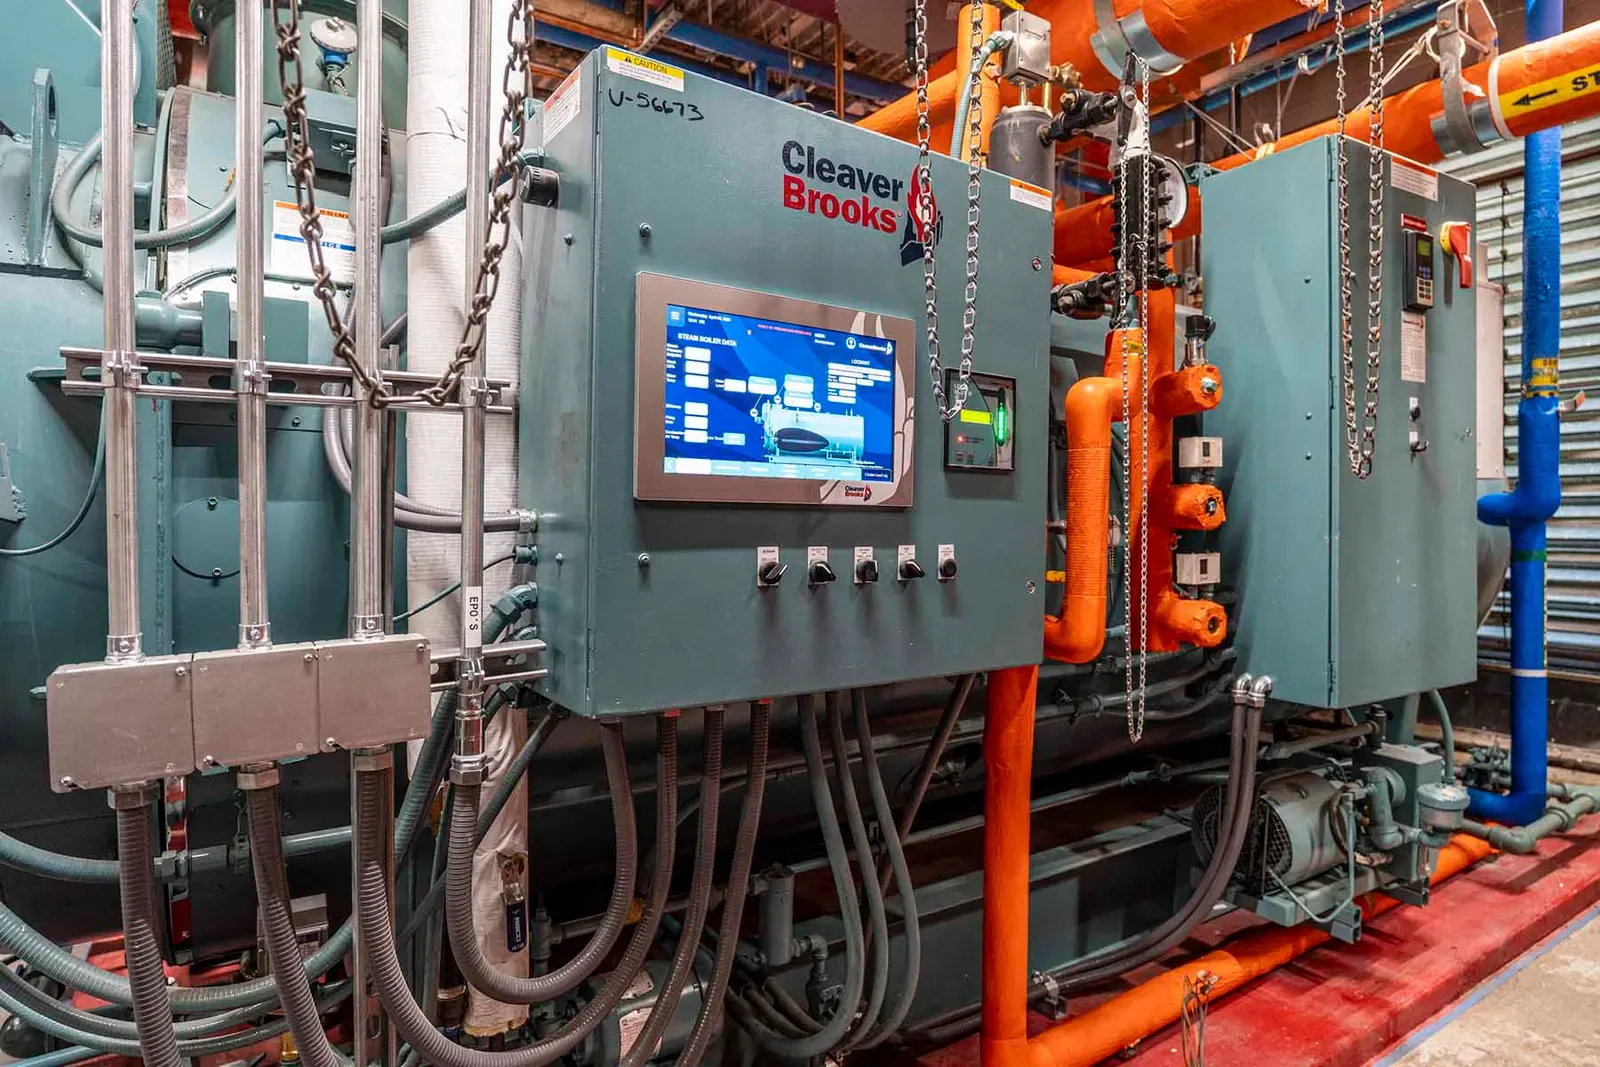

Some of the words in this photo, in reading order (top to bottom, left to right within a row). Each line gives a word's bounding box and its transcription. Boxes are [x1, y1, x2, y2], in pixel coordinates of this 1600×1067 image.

[633, 57, 668, 74] CAUTION
[608, 88, 704, 121] U-56673
[782, 140, 903, 202] Cleaver
[783, 174, 897, 233] Brooks
[677, 332, 699, 342] STEAM
[699, 335, 721, 345] BOILER
[722, 338, 737, 347] DATA
